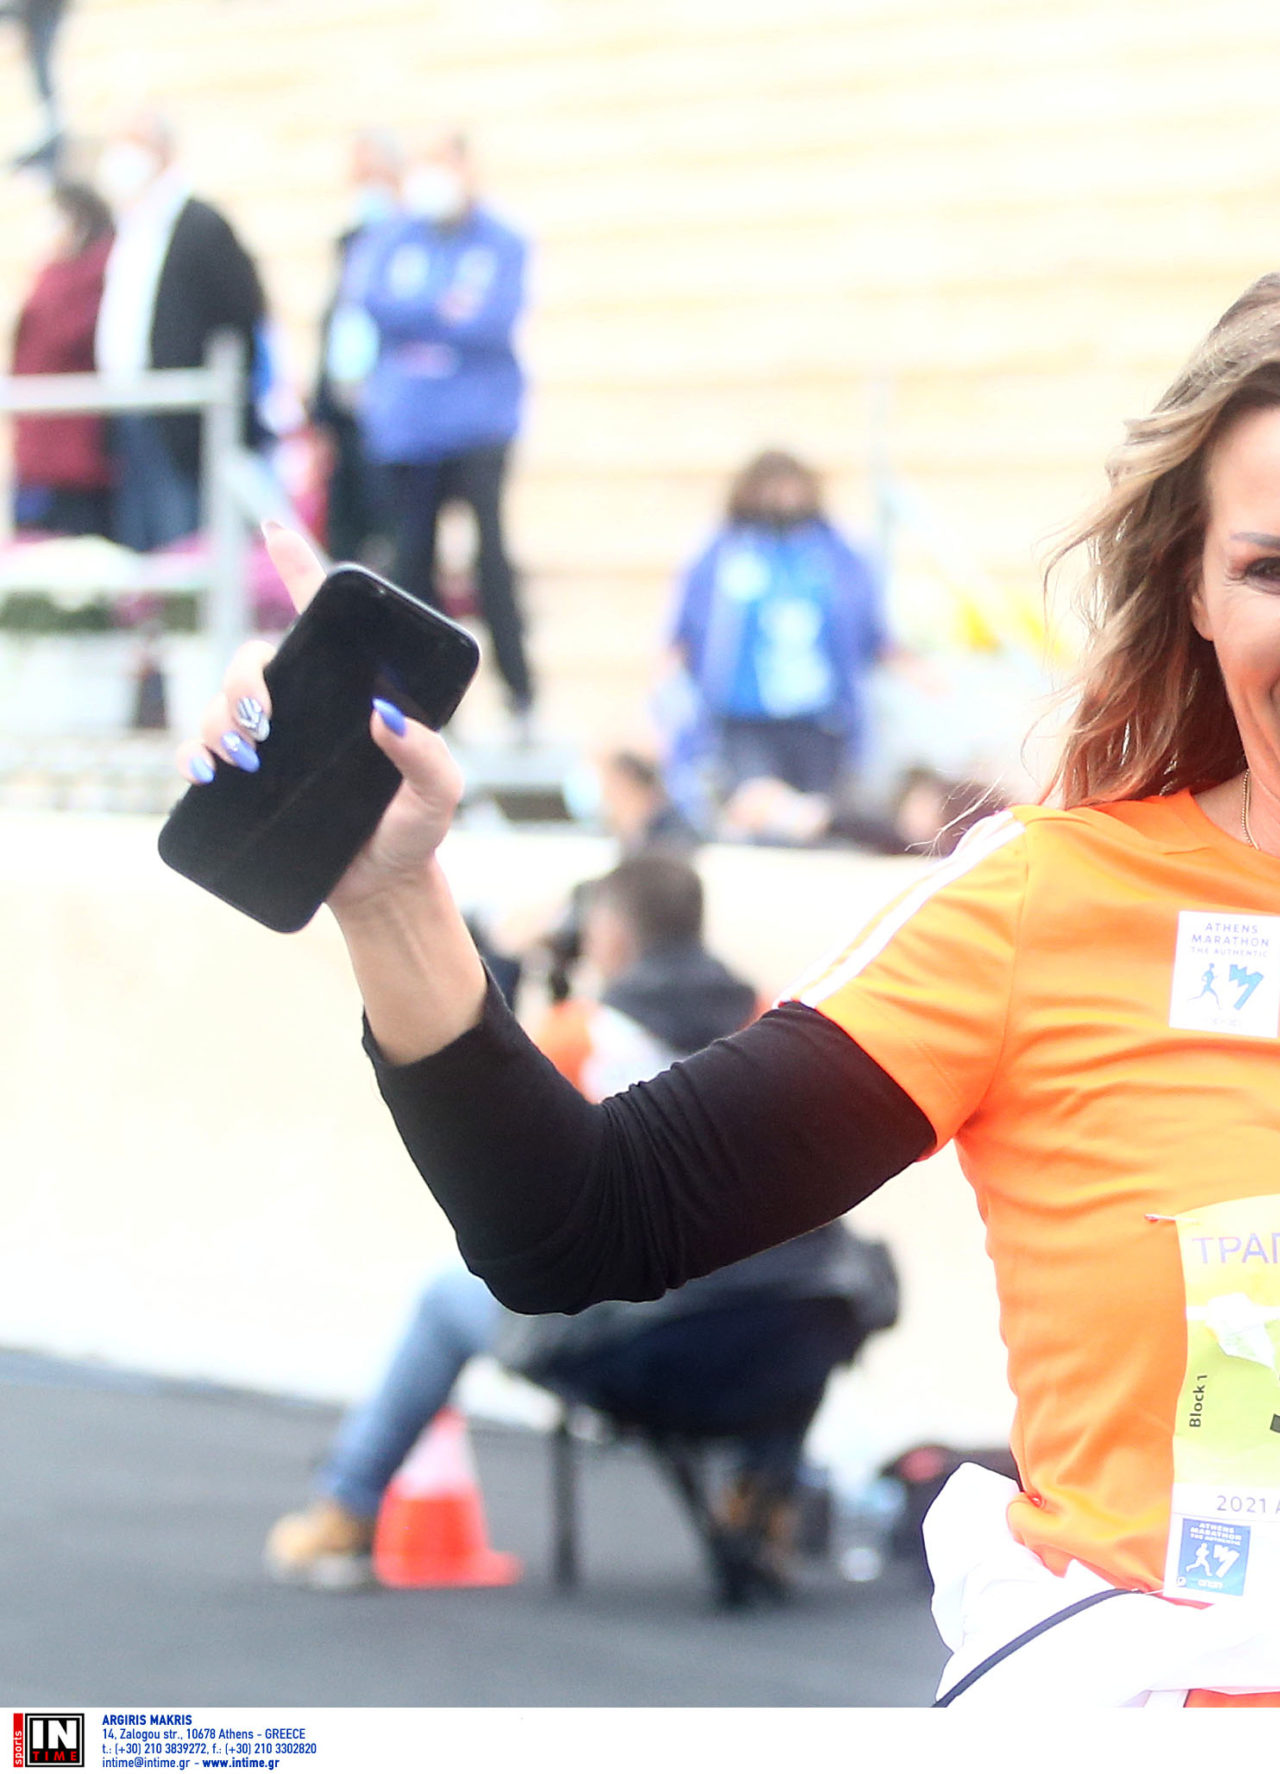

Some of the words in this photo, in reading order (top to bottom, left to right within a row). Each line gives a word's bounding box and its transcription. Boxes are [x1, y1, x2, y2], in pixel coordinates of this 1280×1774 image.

[1204, 922, 1259, 935] ATHENS
[1191, 933, 1270, 948] MARATHON
[1189, 1384, 1206, 1428] Block
[1216, 1495, 1266, 1514] 2021
